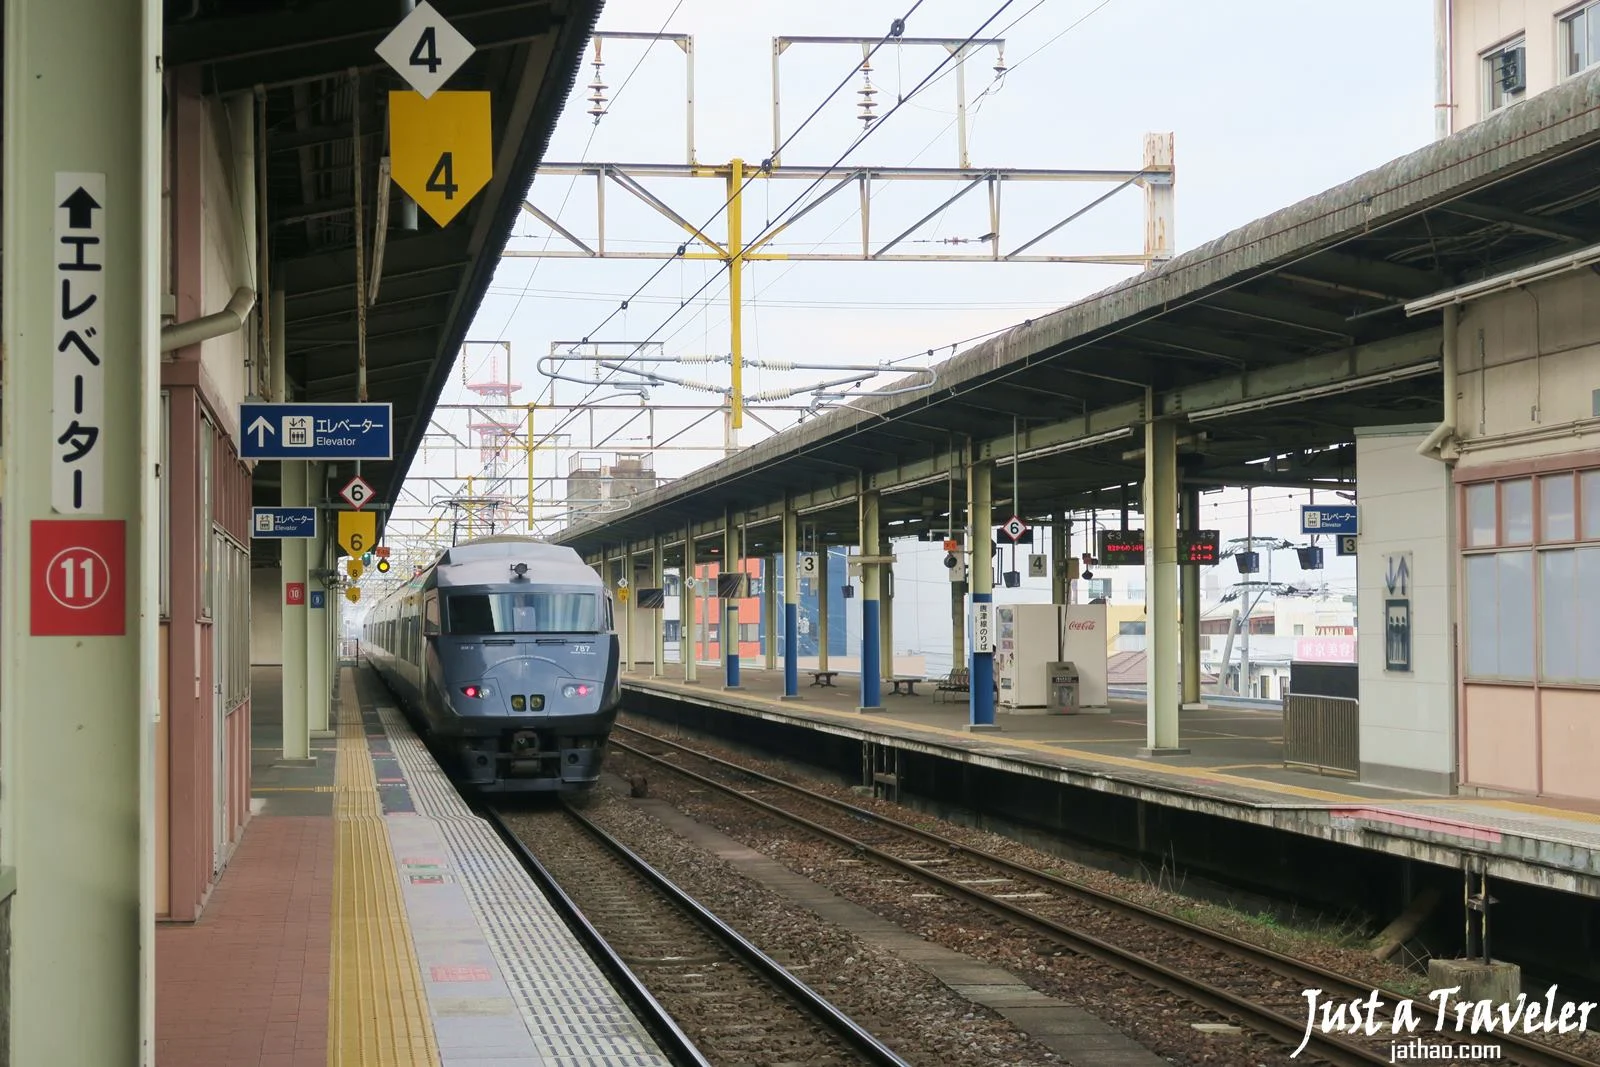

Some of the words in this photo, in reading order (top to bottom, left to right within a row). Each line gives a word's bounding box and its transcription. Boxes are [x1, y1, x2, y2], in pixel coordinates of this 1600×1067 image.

[409, 26, 442, 73] 4
[425, 151, 459, 200] 4
[57, 236, 103, 510] エレベーター
[315, 418, 384, 434] エレベーター
[316, 436, 357, 447] Elevator
[351, 484, 364, 501] 6
[274, 515, 314, 524] エレベーター
[1321, 512, 1357, 521] エレベーター
[1010, 522, 1019, 534] 6
[350, 533, 363, 551] 6
[1115, 532, 1122, 540] 3
[1346, 539, 1355, 552] 3
[804, 557, 815, 572] 3
[1033, 556, 1043, 570] 4
[60, 557, 94, 599] 11
[291, 589, 300, 598] 10
